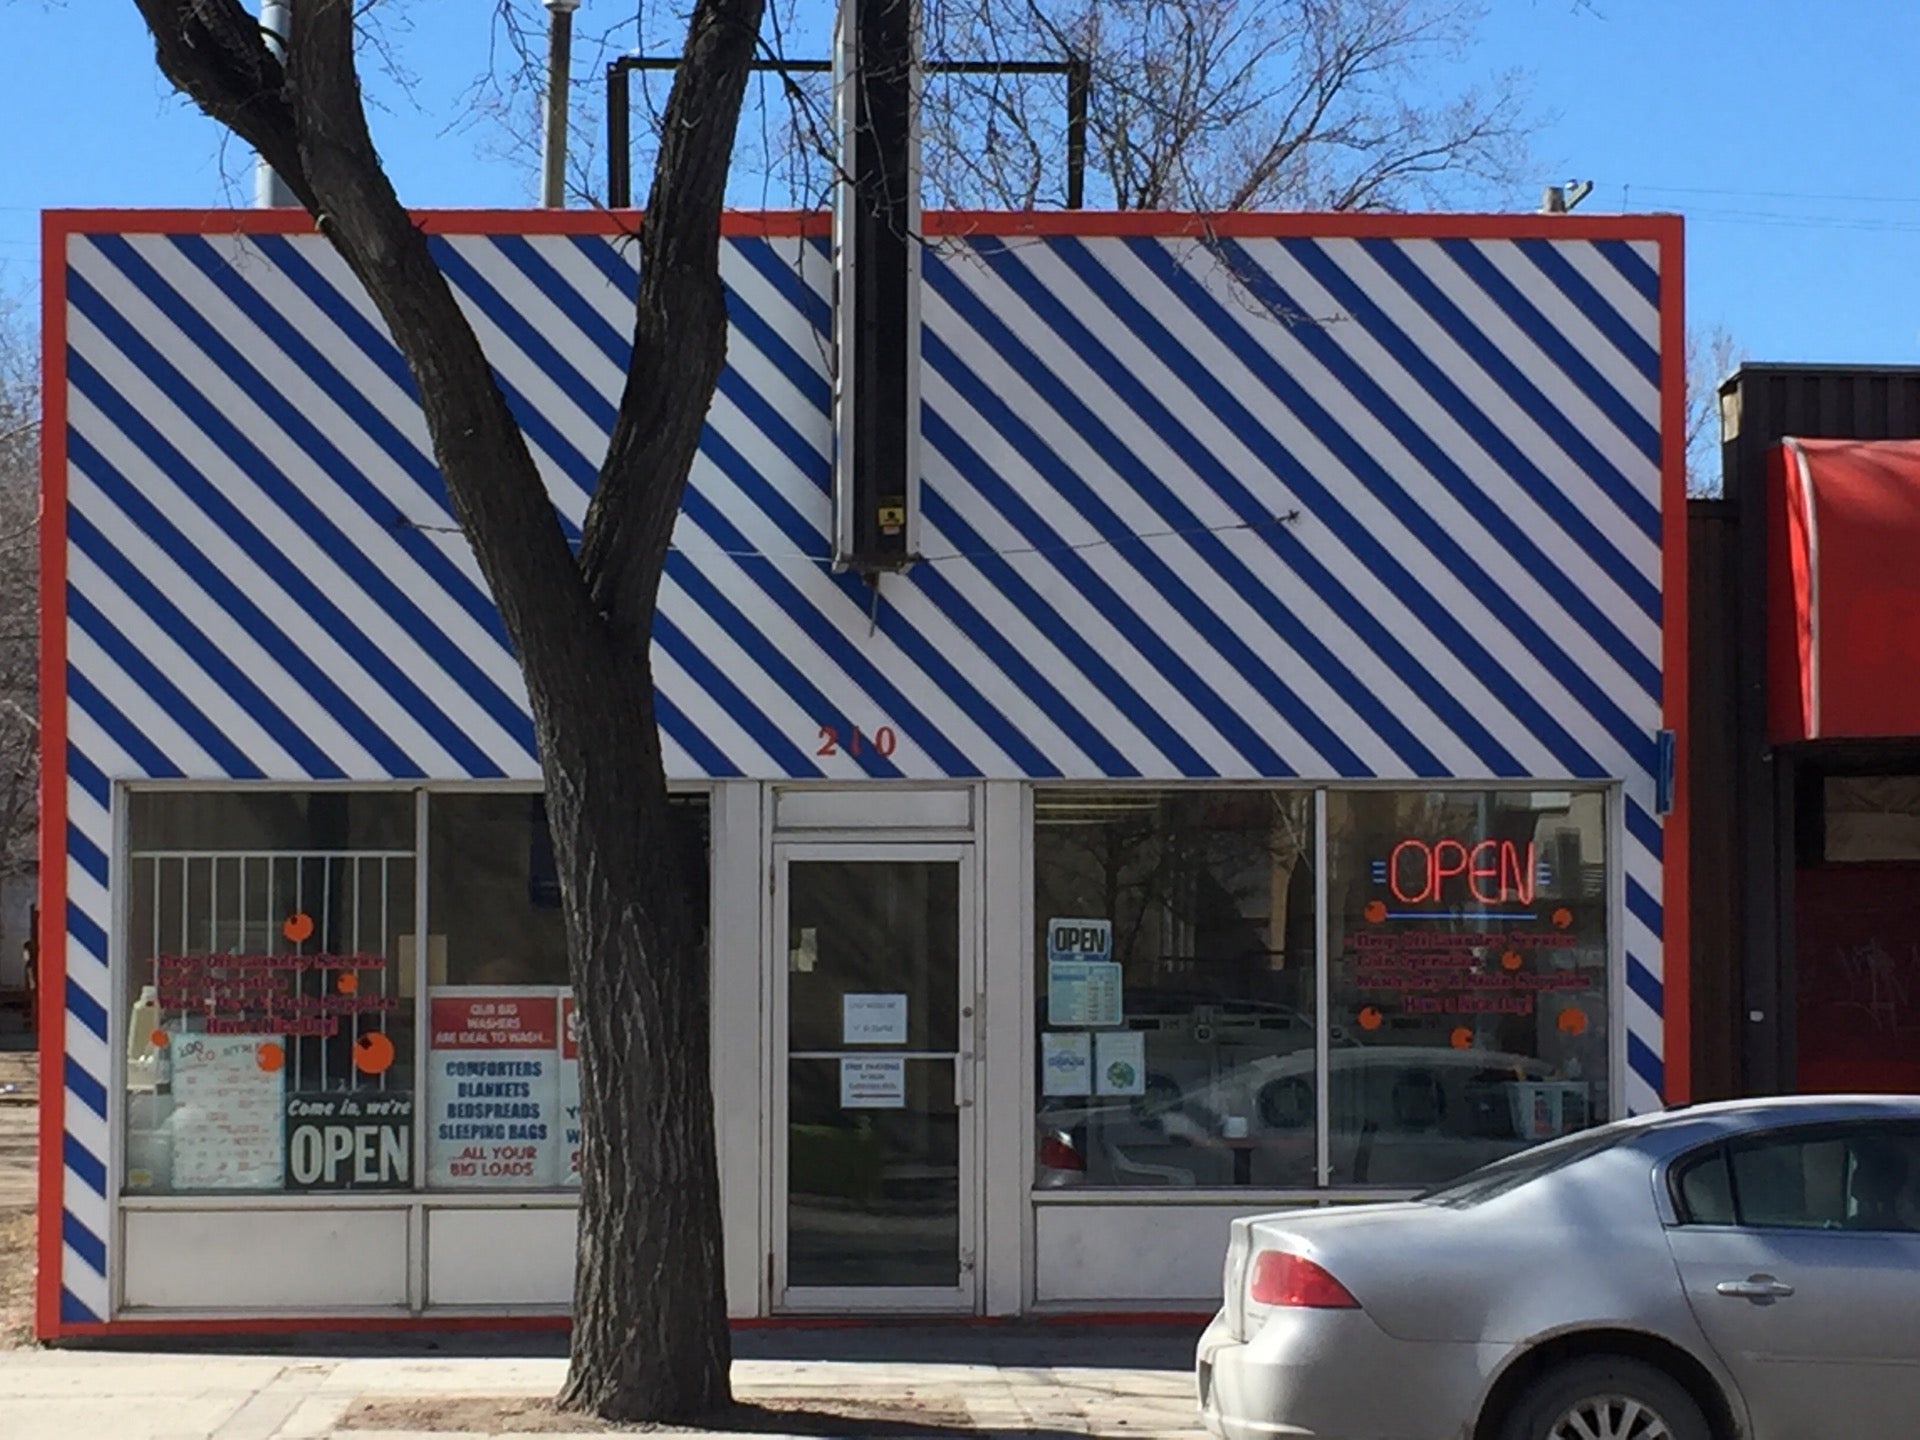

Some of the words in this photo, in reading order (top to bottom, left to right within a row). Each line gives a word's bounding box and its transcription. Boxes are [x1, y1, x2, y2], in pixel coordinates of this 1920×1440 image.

[817, 725, 896, 758] 210
[1389, 839, 1536, 905] OPEN
[1055, 927, 1105, 954] OPEN
[445, 1061, 543, 1078] COMFORTERS
[457, 1082, 531, 1098] BLANKETS
[287, 1099, 335, 1117] Come
[446, 1102, 541, 1119] BEDSPREADS
[438, 1123, 506, 1140] SLEEPING
[508, 1123, 548, 1140] BAGS
[291, 1124, 409, 1185] OPEN
[492, 1144, 537, 1160] YOUR
[482, 1161, 535, 1177] LOADS
